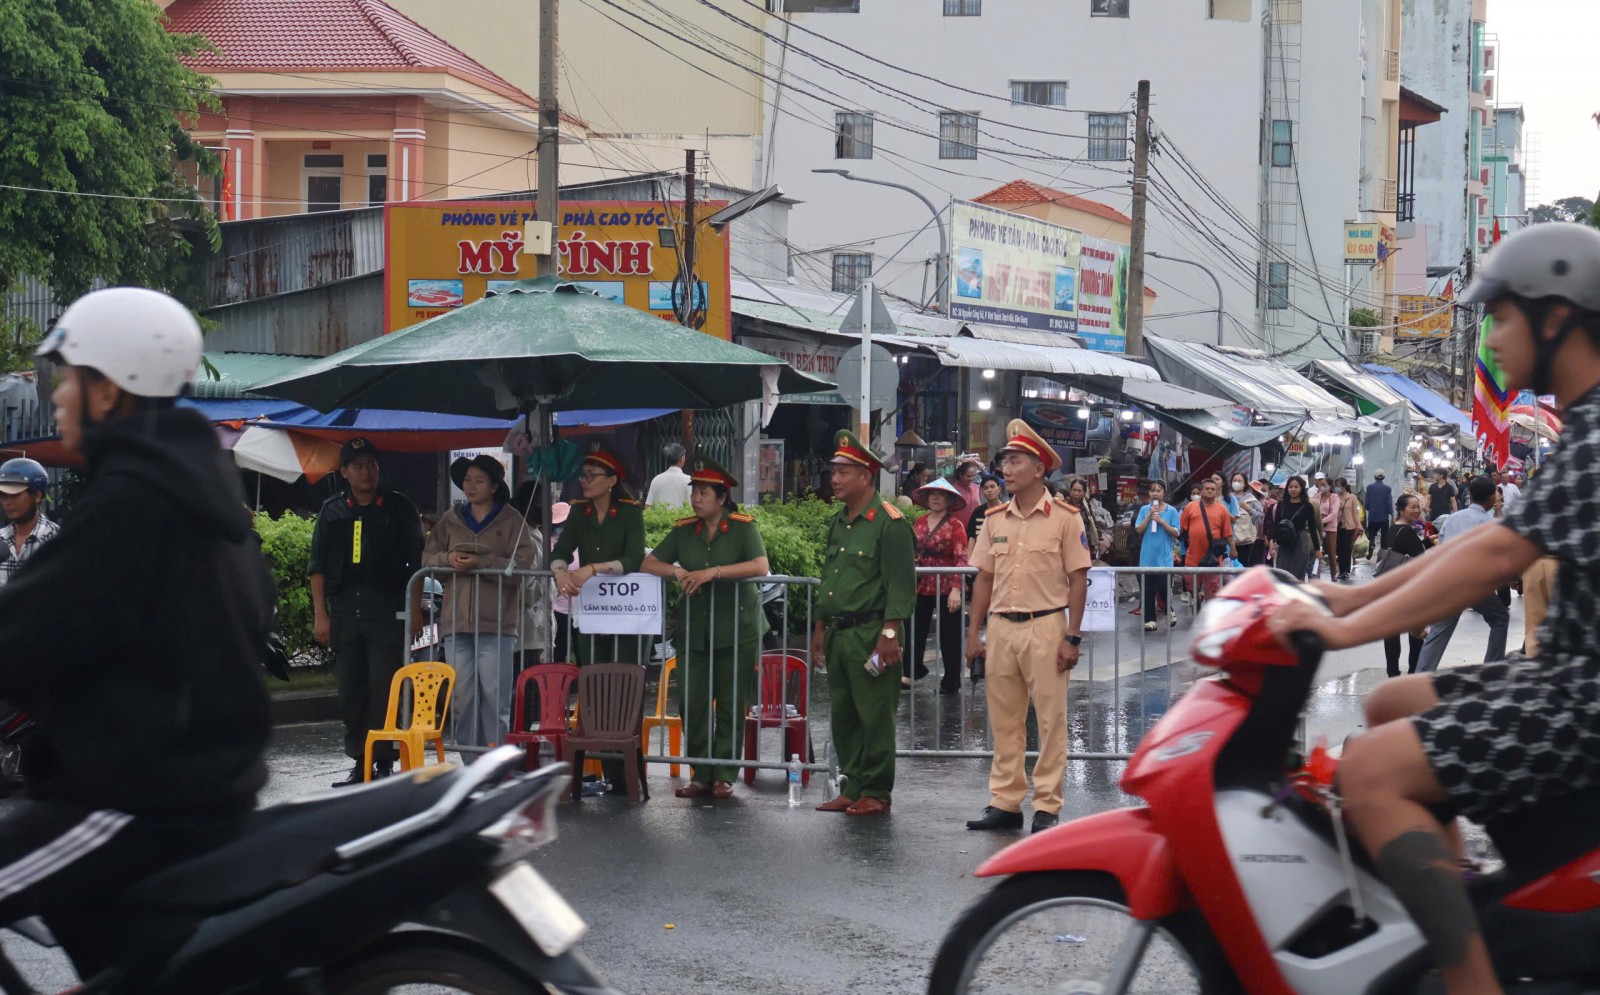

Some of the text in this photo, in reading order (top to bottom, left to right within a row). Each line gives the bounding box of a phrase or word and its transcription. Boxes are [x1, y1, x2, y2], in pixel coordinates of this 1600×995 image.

[441, 209, 496, 226] PHÒNG
[499, 210, 518, 226] VÉ
[563, 209, 595, 226] PHÀ
[598, 213, 630, 226] CAO
[635, 208, 665, 226] TỐC
[969, 215, 996, 242] PHÒNG
[457, 230, 525, 274] MỸ
[816, 350, 834, 374] TÀU
[598, 582, 640, 597] STOP
[610, 603, 623, 612] MÔ
[624, 603, 634, 612] TÔ
[640, 603, 646, 612] Ô
[648, 603, 657, 612] TÔ
